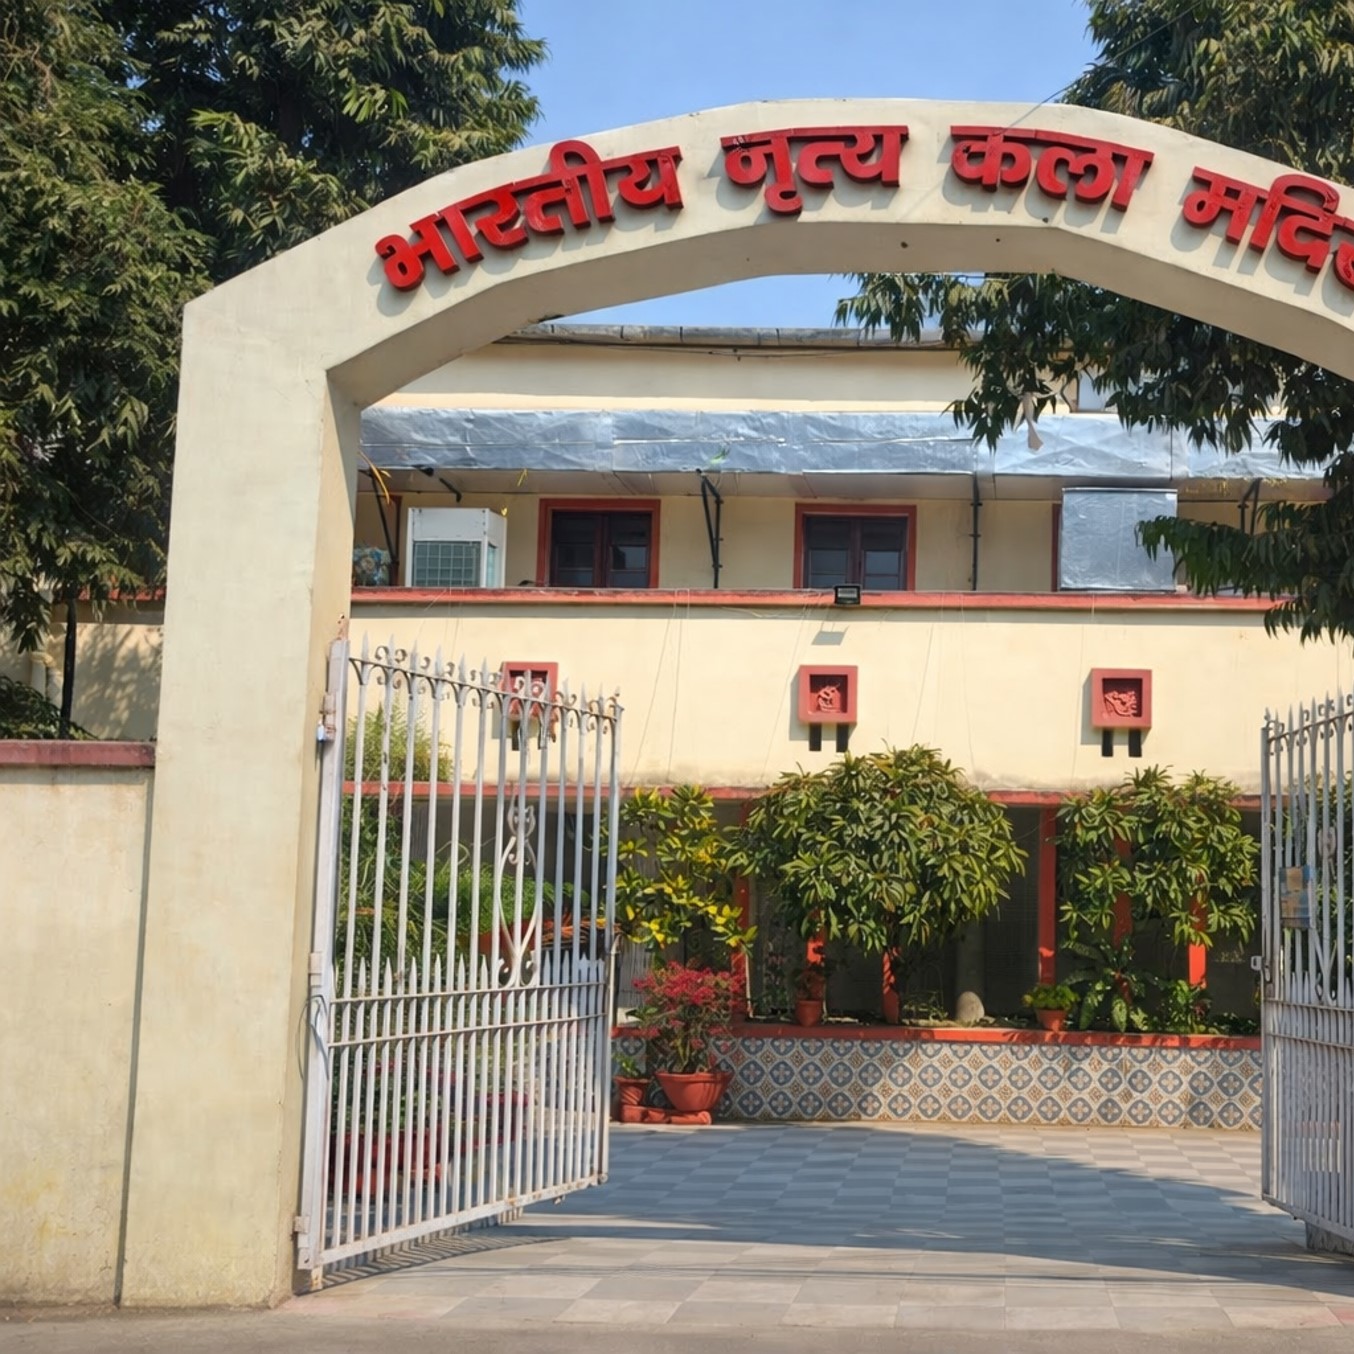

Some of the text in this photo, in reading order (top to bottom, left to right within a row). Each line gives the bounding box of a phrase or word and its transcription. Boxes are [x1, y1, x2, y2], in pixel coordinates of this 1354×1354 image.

[375, 140, 684, 290] भारतीय
[721, 125, 909, 214] नृत्य
[951, 125, 1154, 211] कला
